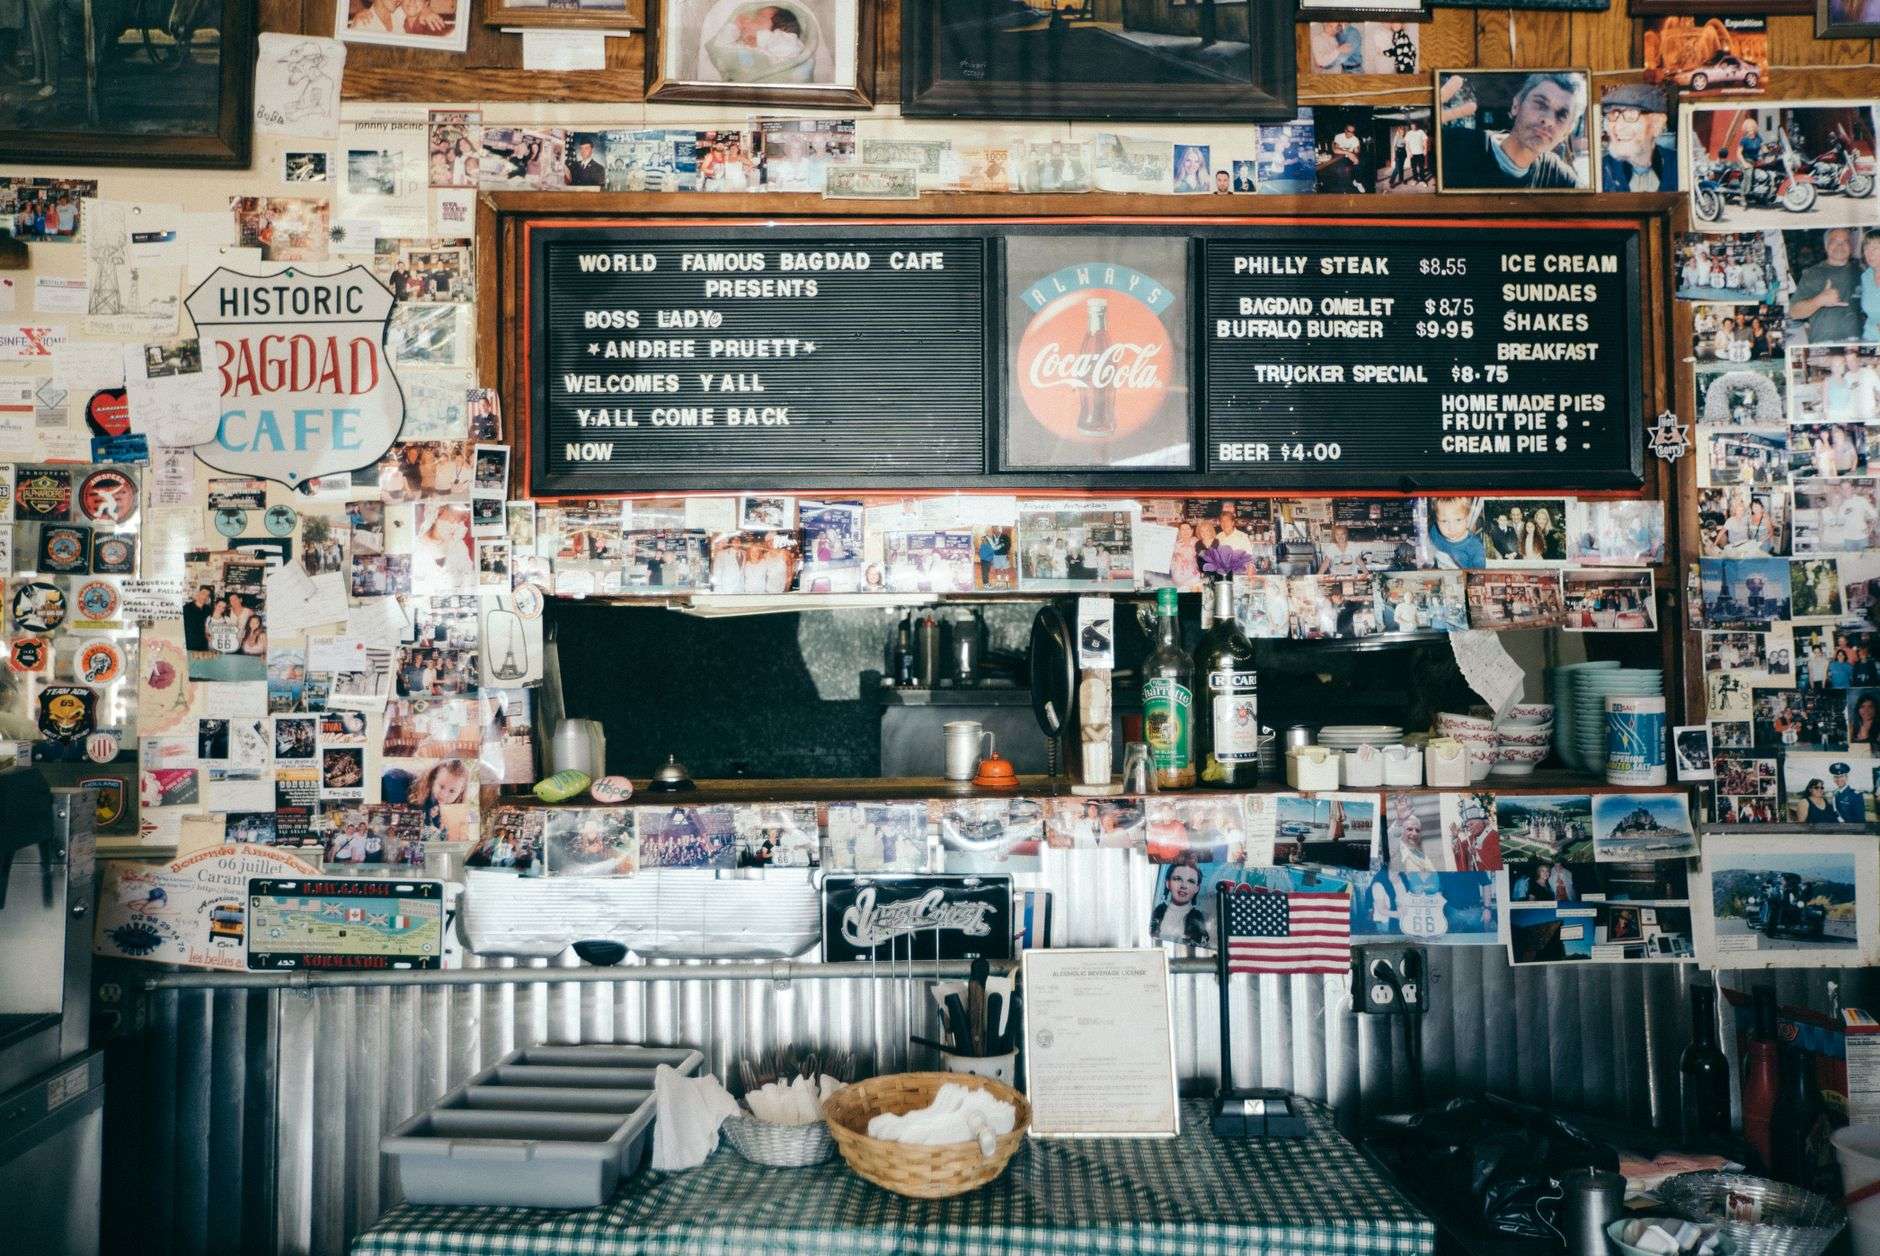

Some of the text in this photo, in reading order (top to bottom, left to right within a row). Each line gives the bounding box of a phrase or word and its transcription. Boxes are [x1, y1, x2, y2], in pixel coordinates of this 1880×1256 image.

[1725, 18, 1764, 28] Expedition
[579, 251, 945, 272] WORLD FAMOUS BAGDAD CAFE
[1234, 256, 1467, 276] PHILLY STEAK $8.55
[1501, 254, 1617, 273] ICE CREAM
[705, 279, 818, 298] PRESENTS
[1031, 267, 1162, 306] ALWAYS
[1502, 283, 1597, 302] SUNDAES
[220, 285, 363, 316] HISTORIC
[1239, 297, 1313, 316] BAGDAD
[1320, 297, 1394, 317] OMELET
[584, 309, 714, 329] BOSS LADY
[1503, 311, 1589, 332] SHAKES
[1216, 320, 1302, 339] BUFFALO
[1307, 320, 1383, 338] BURGER
[604, 339, 799, 358] ANDREE PRUETT
[1497, 343, 1599, 361] BREAKFAST
[1029, 342, 1161, 389] Coca-Cola
[1254, 364, 1345, 382] TRUCKER
[1352, 364, 1428, 383] SPECIAL
[564, 373, 680, 393] WELCOMES
[1441, 394, 1606, 412] HOME MADE PIES
[651, 408, 714, 426] COME
[727, 407, 790, 425] BACK
[1442, 413, 1508, 430] FRUIT
[1514, 413, 1547, 430] PIE
[216, 408, 364, 453] CAFE
[565, 443, 614, 461] NOW
[1219, 443, 1269, 461] BEER
[1441, 436, 1511, 453] CREAM
[1516, 436, 1548, 453] PIE
[217, 640, 231, 649] 66
[46, 688, 70, 697] TEAM
[594, 778, 632, 800] Hope
[218, 859, 233, 870] 06
[238, 858, 283, 875] juillet
[1412, 916, 1436, 933] 66
[204, 948, 234, 967] belles
